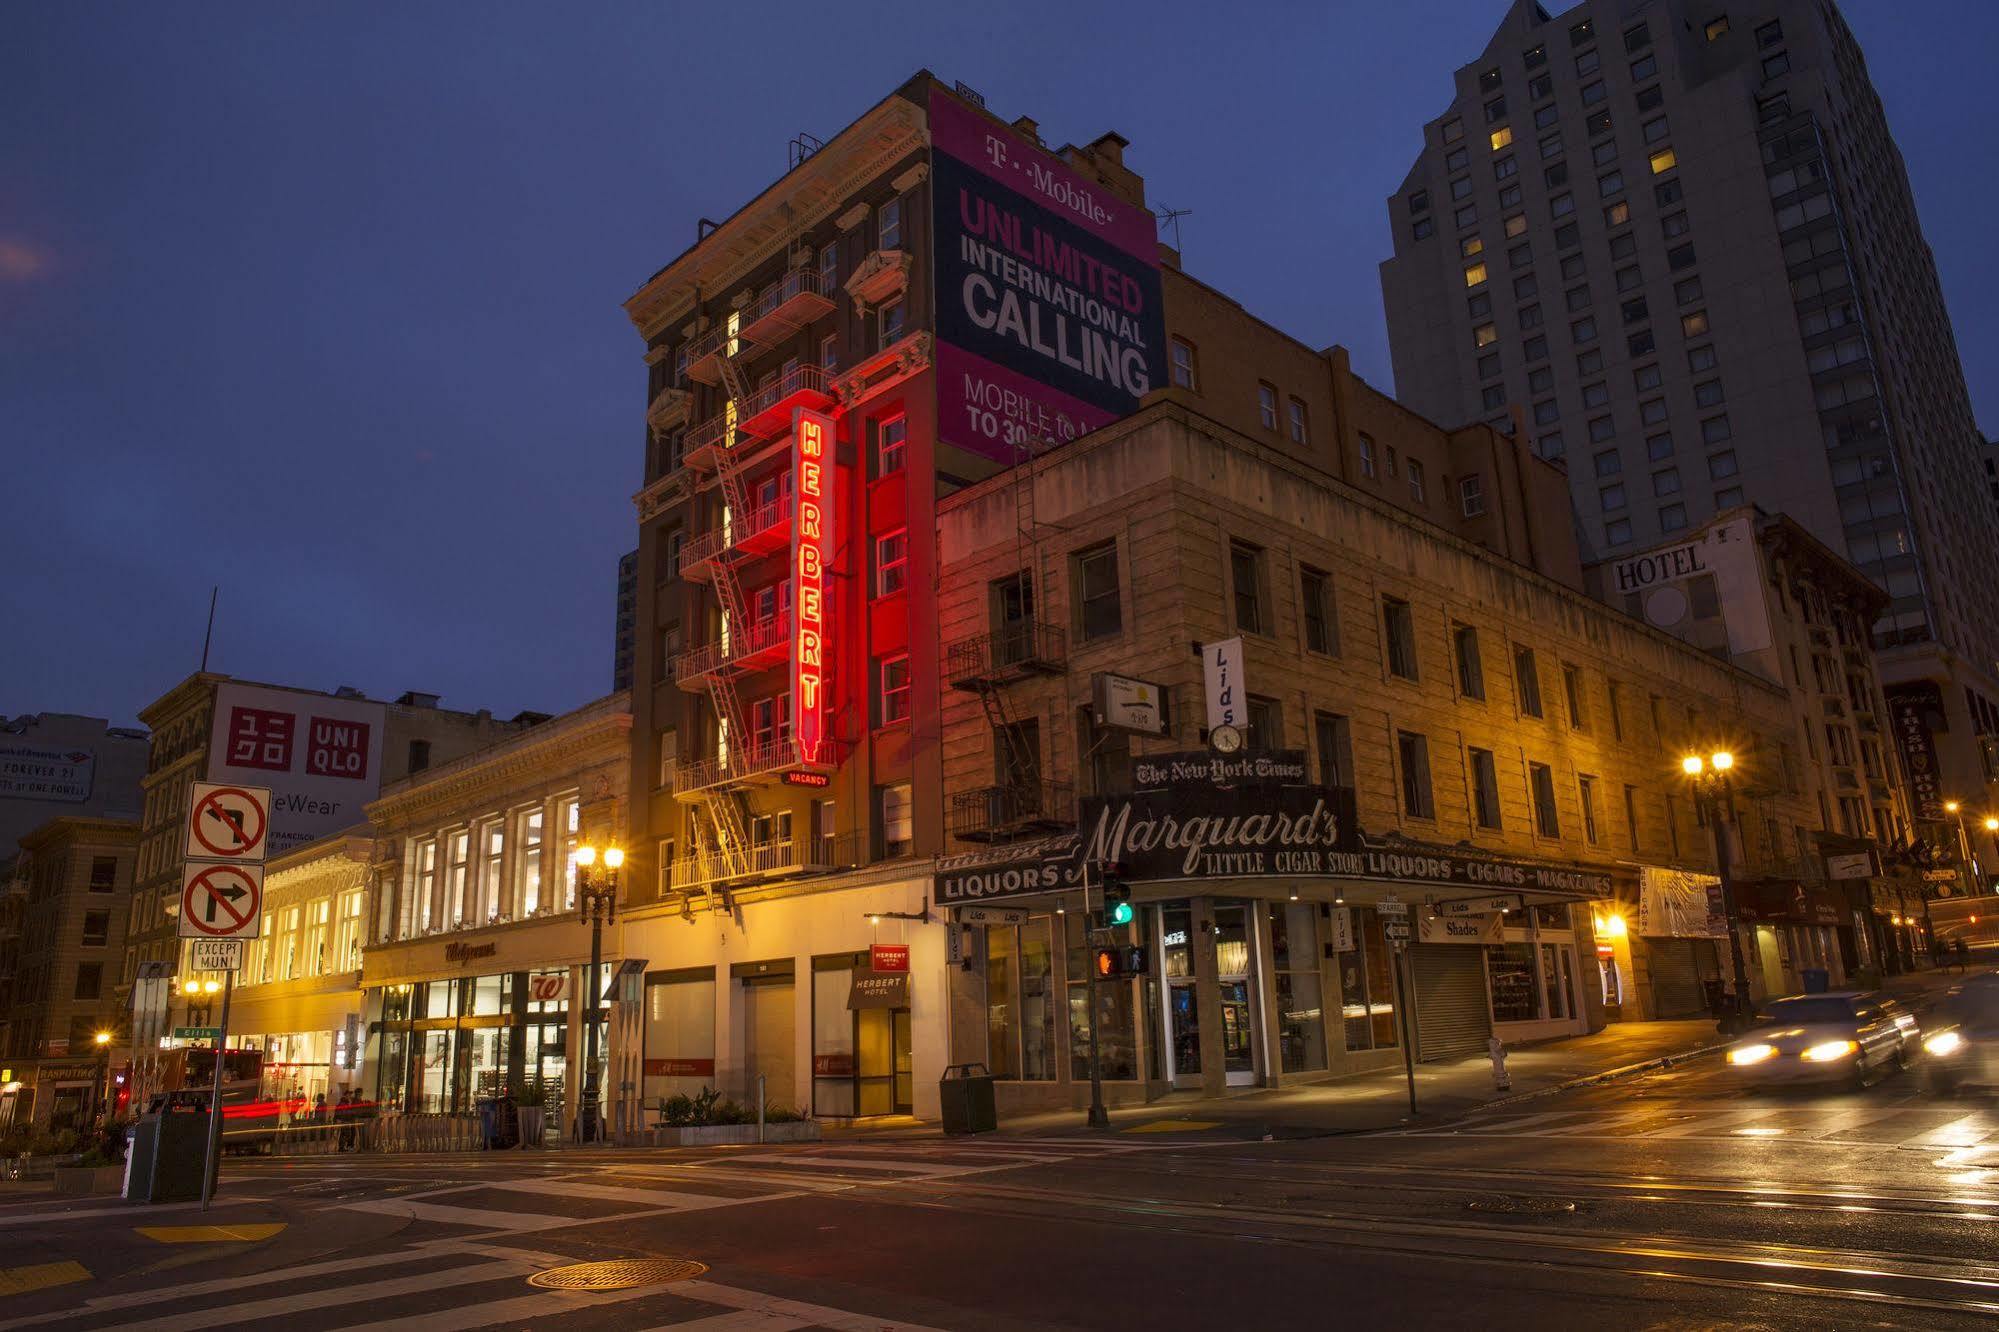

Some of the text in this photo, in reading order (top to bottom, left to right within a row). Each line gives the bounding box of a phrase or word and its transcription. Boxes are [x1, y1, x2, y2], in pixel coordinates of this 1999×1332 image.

[960, 187, 1144, 316] UNLIMITED
[960, 234, 1147, 348] INTERNATIONAL
[962, 272, 1150, 399] CALLING
[965, 373, 1051, 433] MOBILE
[966, 405, 998, 438] TO
[800, 421, 821, 709] HERBERT
[1617, 545, 1706, 590] HOTEL
[1216, 648, 1234, 725] Lids
[790, 773, 827, 785] VACANCY
[1136, 757, 1305, 785] The New York Times
[271, 793, 341, 816] eWear
[1065, 798, 1338, 882] Marquard's
[1275, 851, 1321, 873] CIGAR
[1369, 852, 1451, 878] LIQUORS
[1467, 861, 1526, 885] CIGARS
[944, 864, 1059, 898] LIQUORS
[1447, 921, 1478, 936] Shades
[198, 943, 237, 955] EXCEPT
[201, 956, 233, 968] MUNI
[856, 977, 901, 989] HERBERT
[864, 988, 888, 996] HOTEL
[184, 1028, 212, 1038] Ellis
